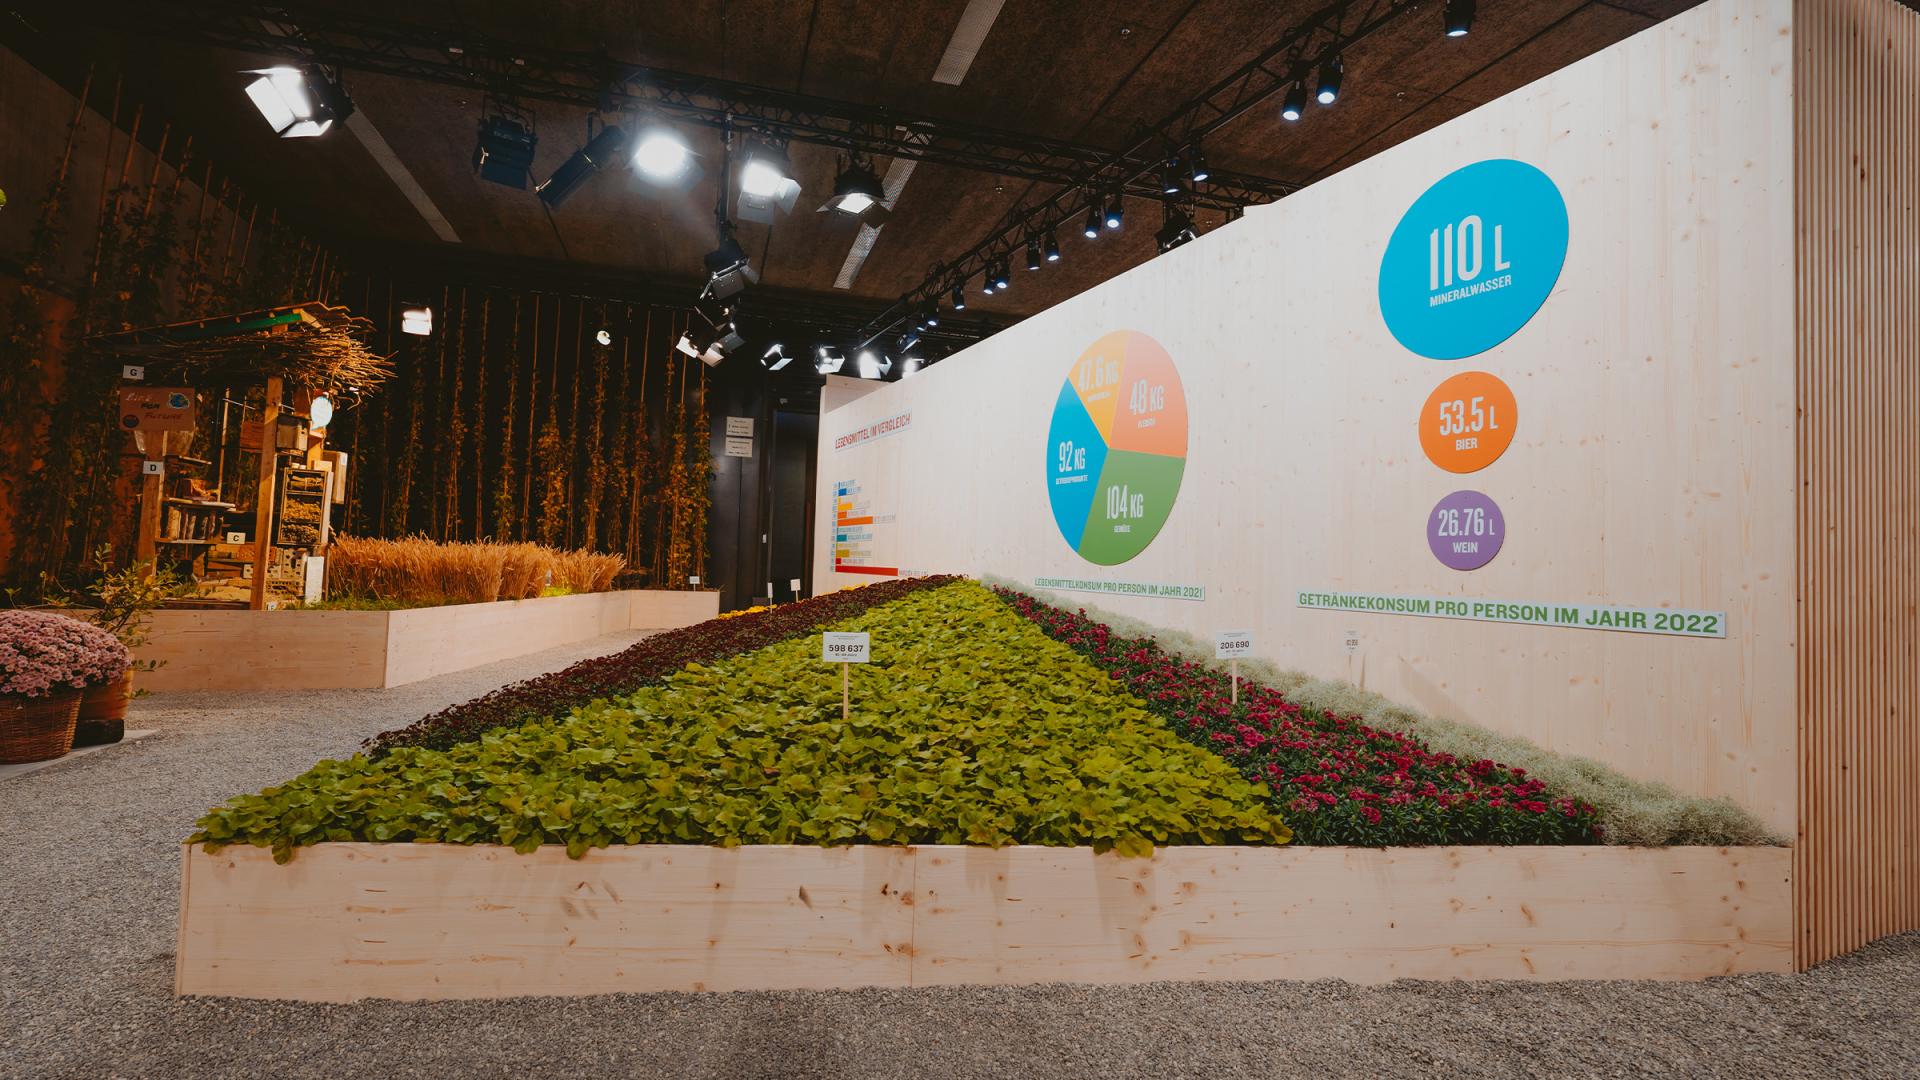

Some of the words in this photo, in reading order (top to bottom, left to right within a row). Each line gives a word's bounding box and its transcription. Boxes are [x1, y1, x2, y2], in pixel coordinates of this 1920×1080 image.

[1429, 214, 1483, 291] 110
[1494, 224, 1511, 272] L
[1429, 274, 1512, 307] MINERALWASSER
[129, 368, 138, 377] G
[1078, 355, 1104, 393] 47.6
[1105, 359, 1119, 386] KG
[1130, 379, 1147, 416] 48
[1150, 383, 1165, 412] KG
[835, 428, 870, 449] LEBENSMITTEL
[870, 424, 877, 438] IM
[877, 413, 911, 436] VERGLEICH
[1439, 396, 1484, 436] 53.5
[1489, 405, 1499, 430] L
[1058, 440, 1073, 473] 92
[1074, 447, 1086, 470] KG
[1455, 437, 1478, 451] BIER
[149, 463, 157, 472] D
[1106, 484, 1128, 520] 104
[1130, 493, 1144, 518] KG
[1437, 507, 1485, 537] 26.76
[1489, 518, 1496, 536] L
[232, 534, 240, 542] C
[1452, 541, 1479, 553] WEIN
[1034, 577, 1102, 592] LEBENSMITTELKONSUM
[1103, 582, 1117, 592] PRO
[1118, 582, 1147, 594] PERSON
[1148, 584, 1158, 595] IM
[1159, 585, 1181, 596] JAHR
[1183, 586, 1203, 599] 2021
[1299, 592, 1430, 614] GETRÄNKEKONSUM
[1434, 600, 1469, 617] PRO
[1473, 602, 1549, 623] PERSON
[1554, 607, 1580, 624] IM
[1585, 609, 1648, 629] JAHR
[1653, 612, 1719, 634] 2022
[828, 644, 846, 652] 598
[847, 644, 864, 652] 637
[1235, 640, 1250, 649] 690
